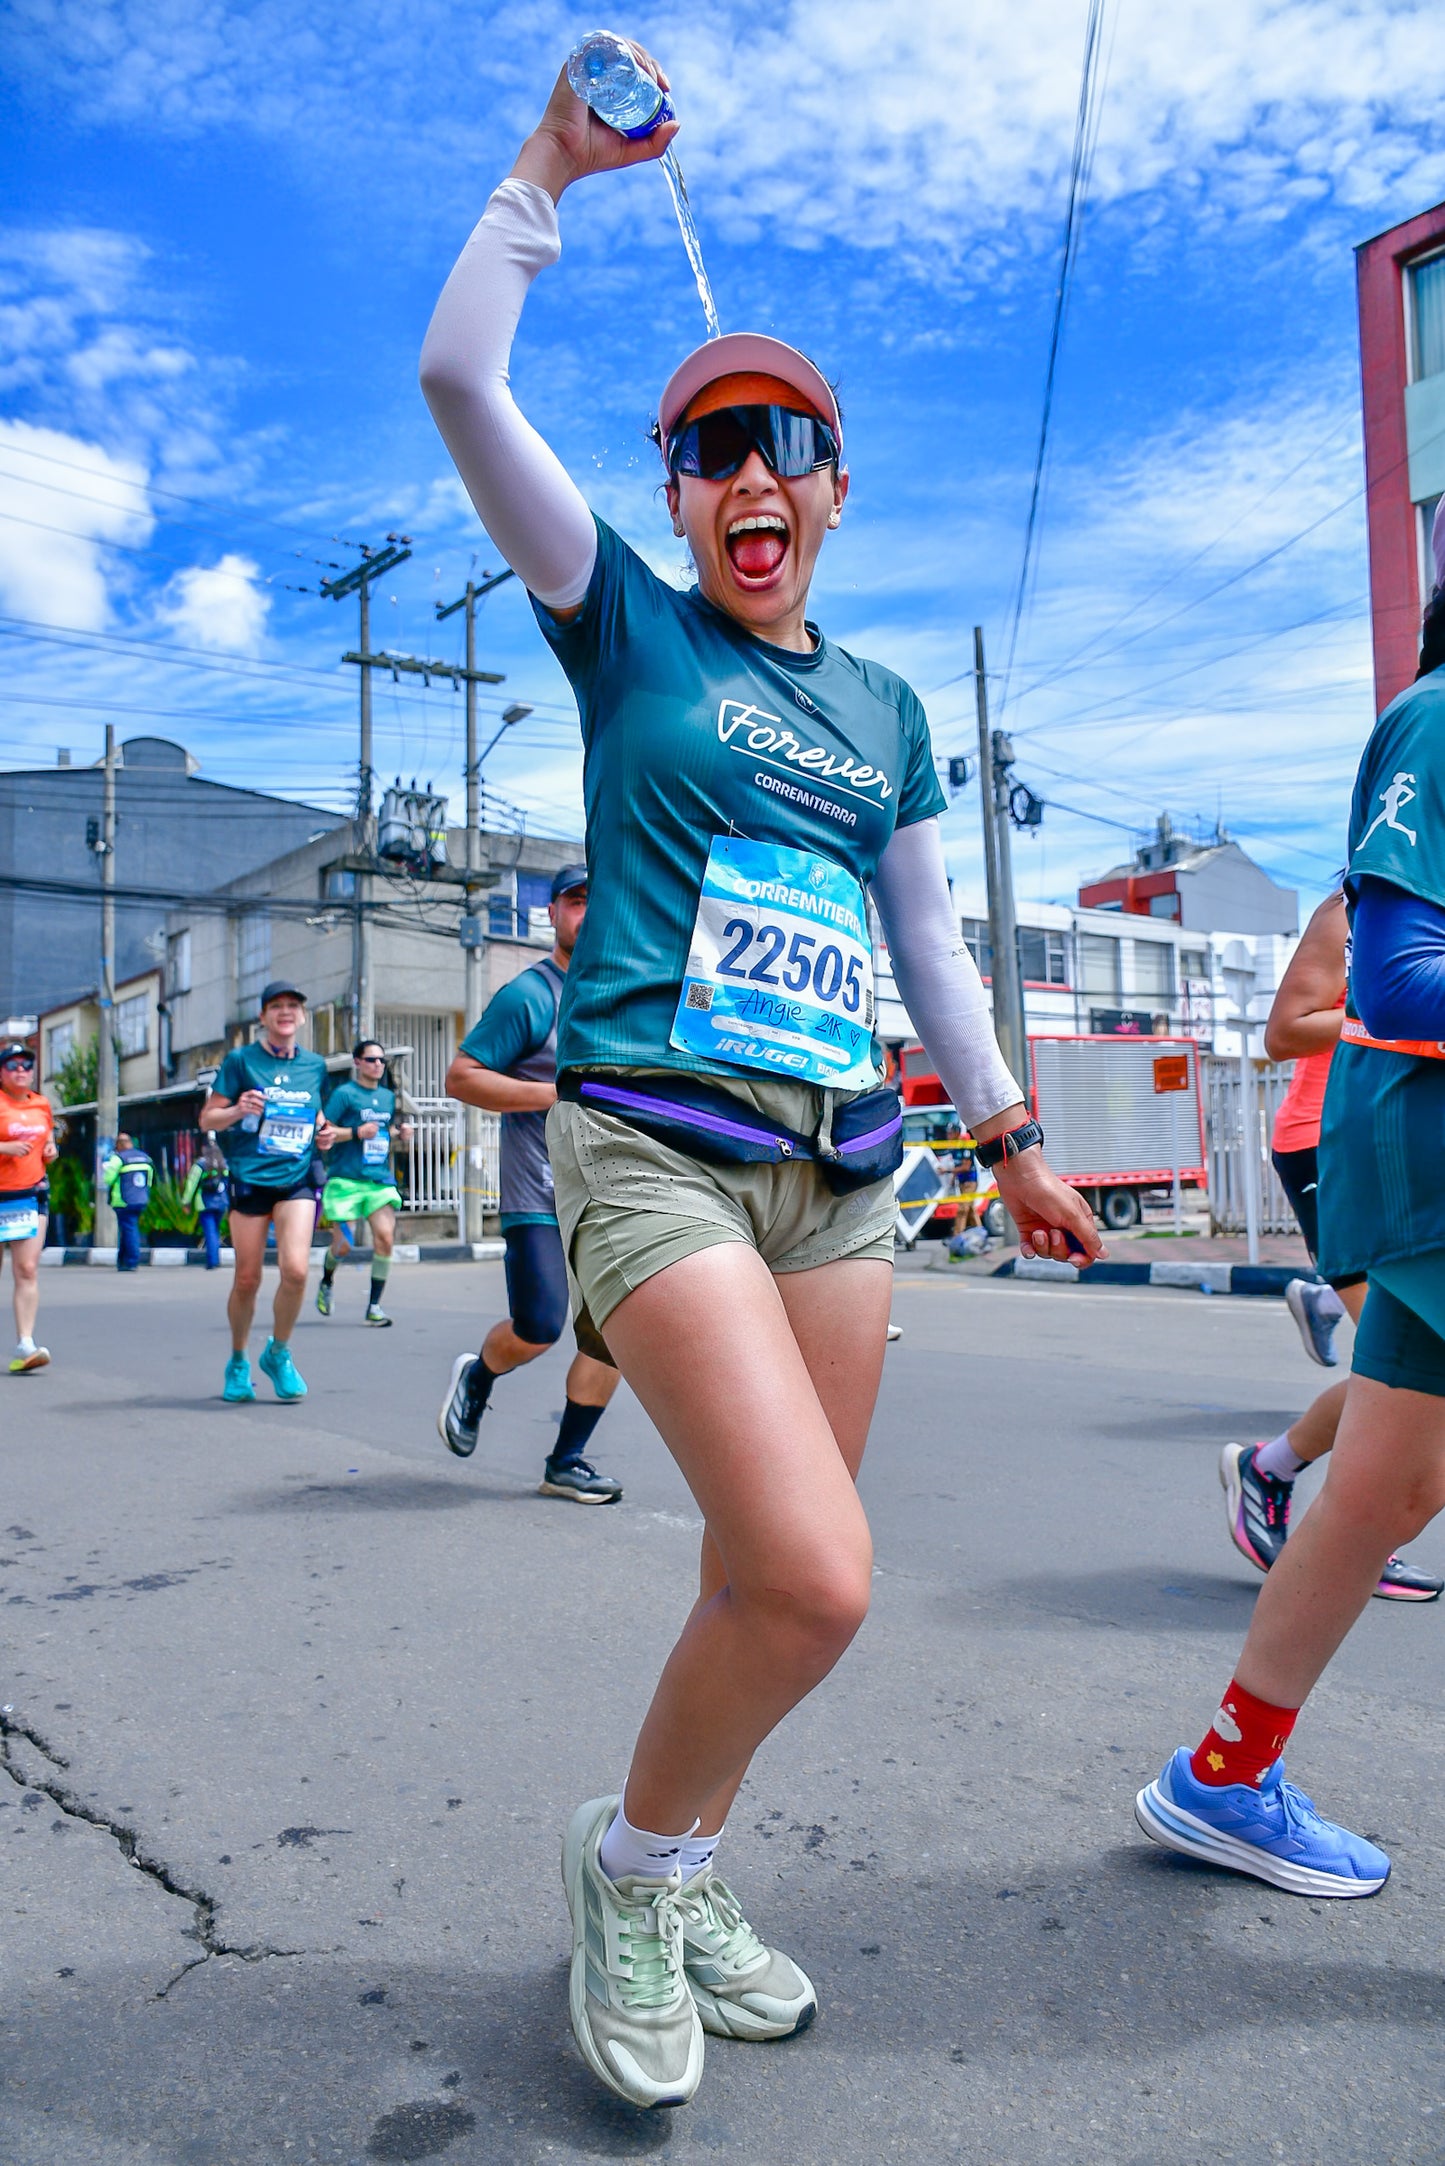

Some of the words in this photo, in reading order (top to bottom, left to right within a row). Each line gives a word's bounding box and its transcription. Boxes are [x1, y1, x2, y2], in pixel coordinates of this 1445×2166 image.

[717, 698, 893, 799] Forever
[754, 772, 858, 827] CORREMITIERRA
[732, 879, 862, 938] CORREMITIERR
[715, 918, 863, 1013] 22505
[738, 989, 807, 1026] Angie
[814, 1013, 843, 1041] 21K
